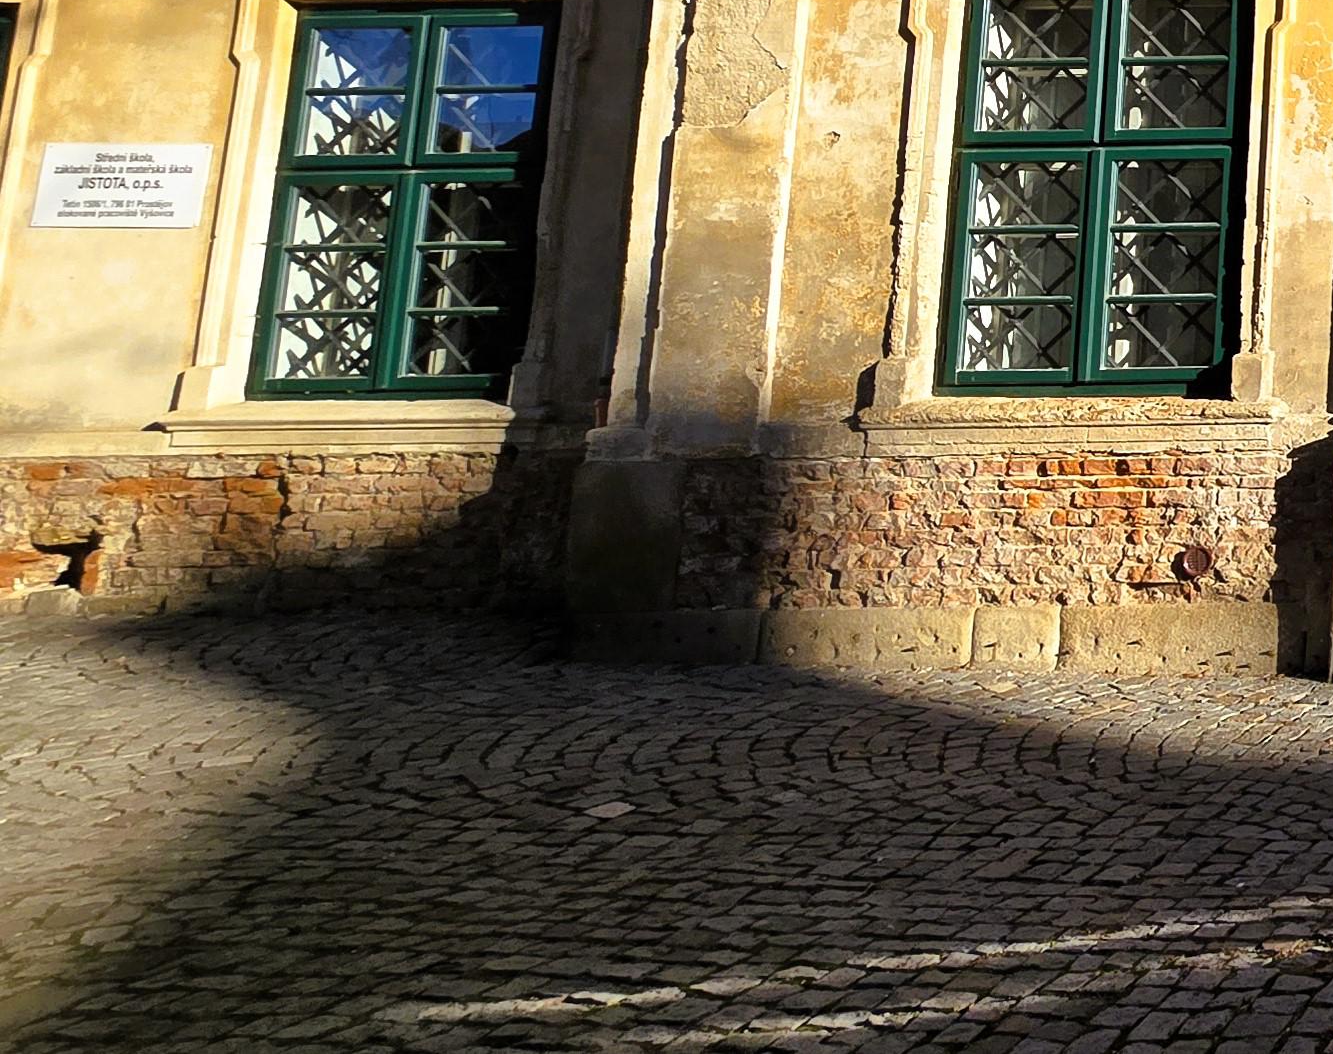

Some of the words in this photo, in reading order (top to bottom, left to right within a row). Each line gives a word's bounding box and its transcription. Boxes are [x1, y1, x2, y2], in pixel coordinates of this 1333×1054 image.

[95, 152, 127, 163] Střední
[92, 164, 116, 174] škola
[118, 166, 124, 174] a
[168, 164, 193, 174] škola
[77, 176, 130, 190] JISTOTA,
[132, 179, 164, 192] o.p.s.
